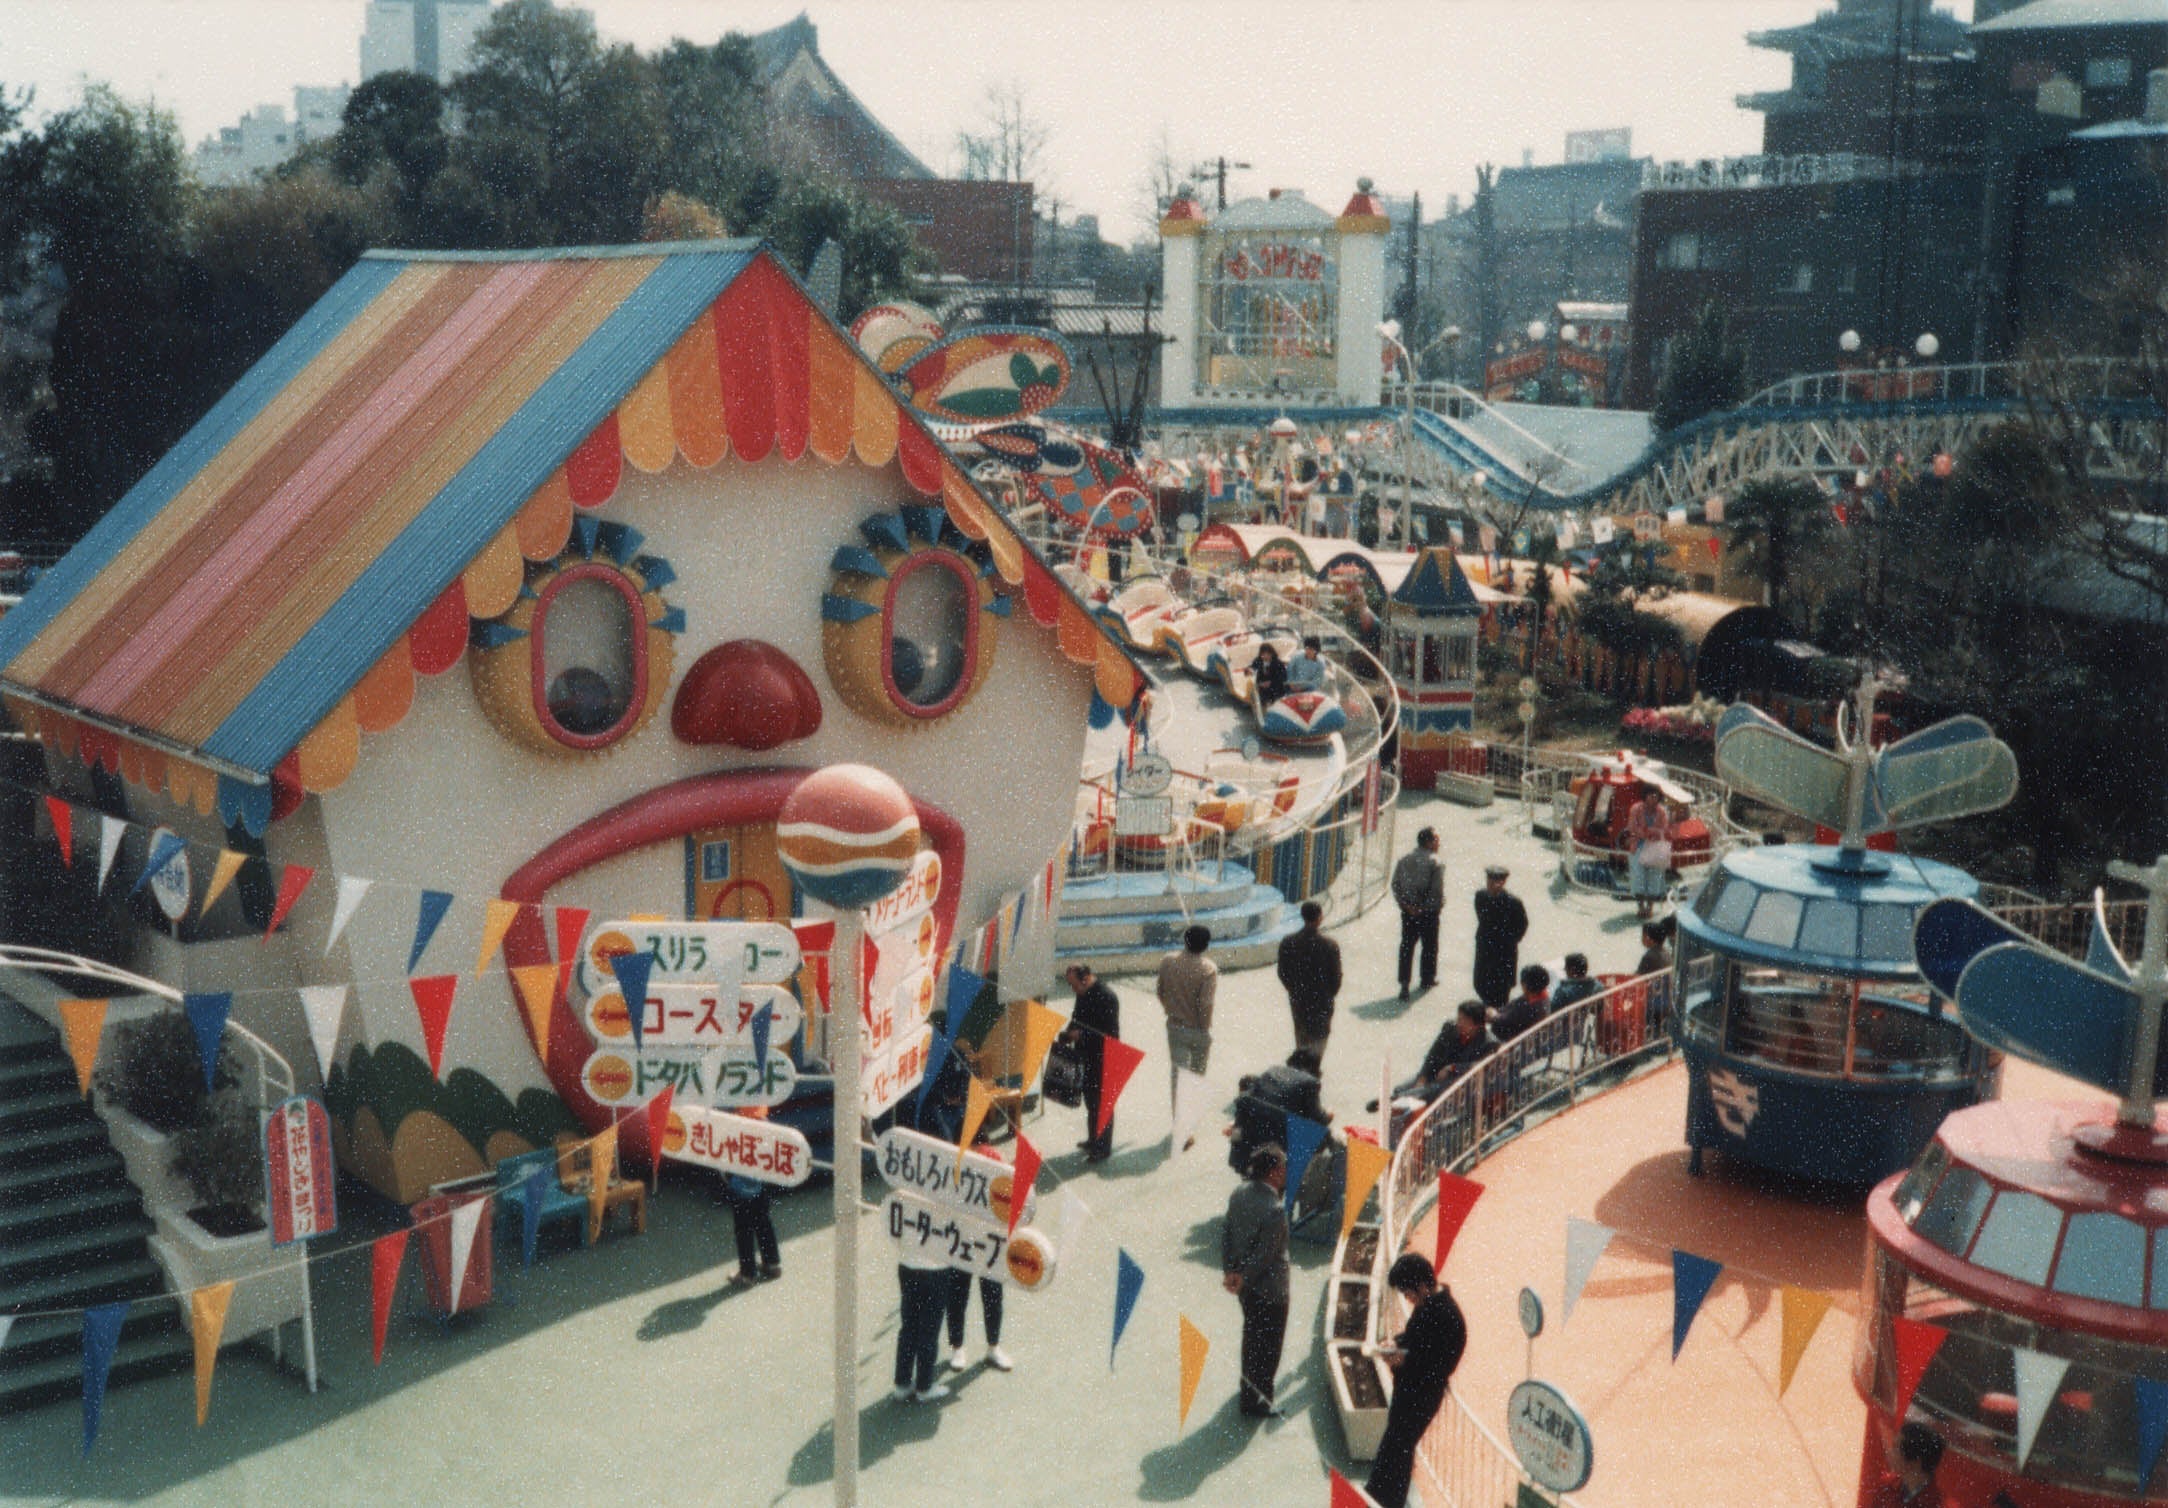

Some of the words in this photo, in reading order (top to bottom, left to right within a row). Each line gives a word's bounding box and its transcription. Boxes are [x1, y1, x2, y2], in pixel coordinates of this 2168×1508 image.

[690, 1120, 799, 1176] きしゃぽっぽ
[885, 1140, 988, 1208] おもしろハウス
